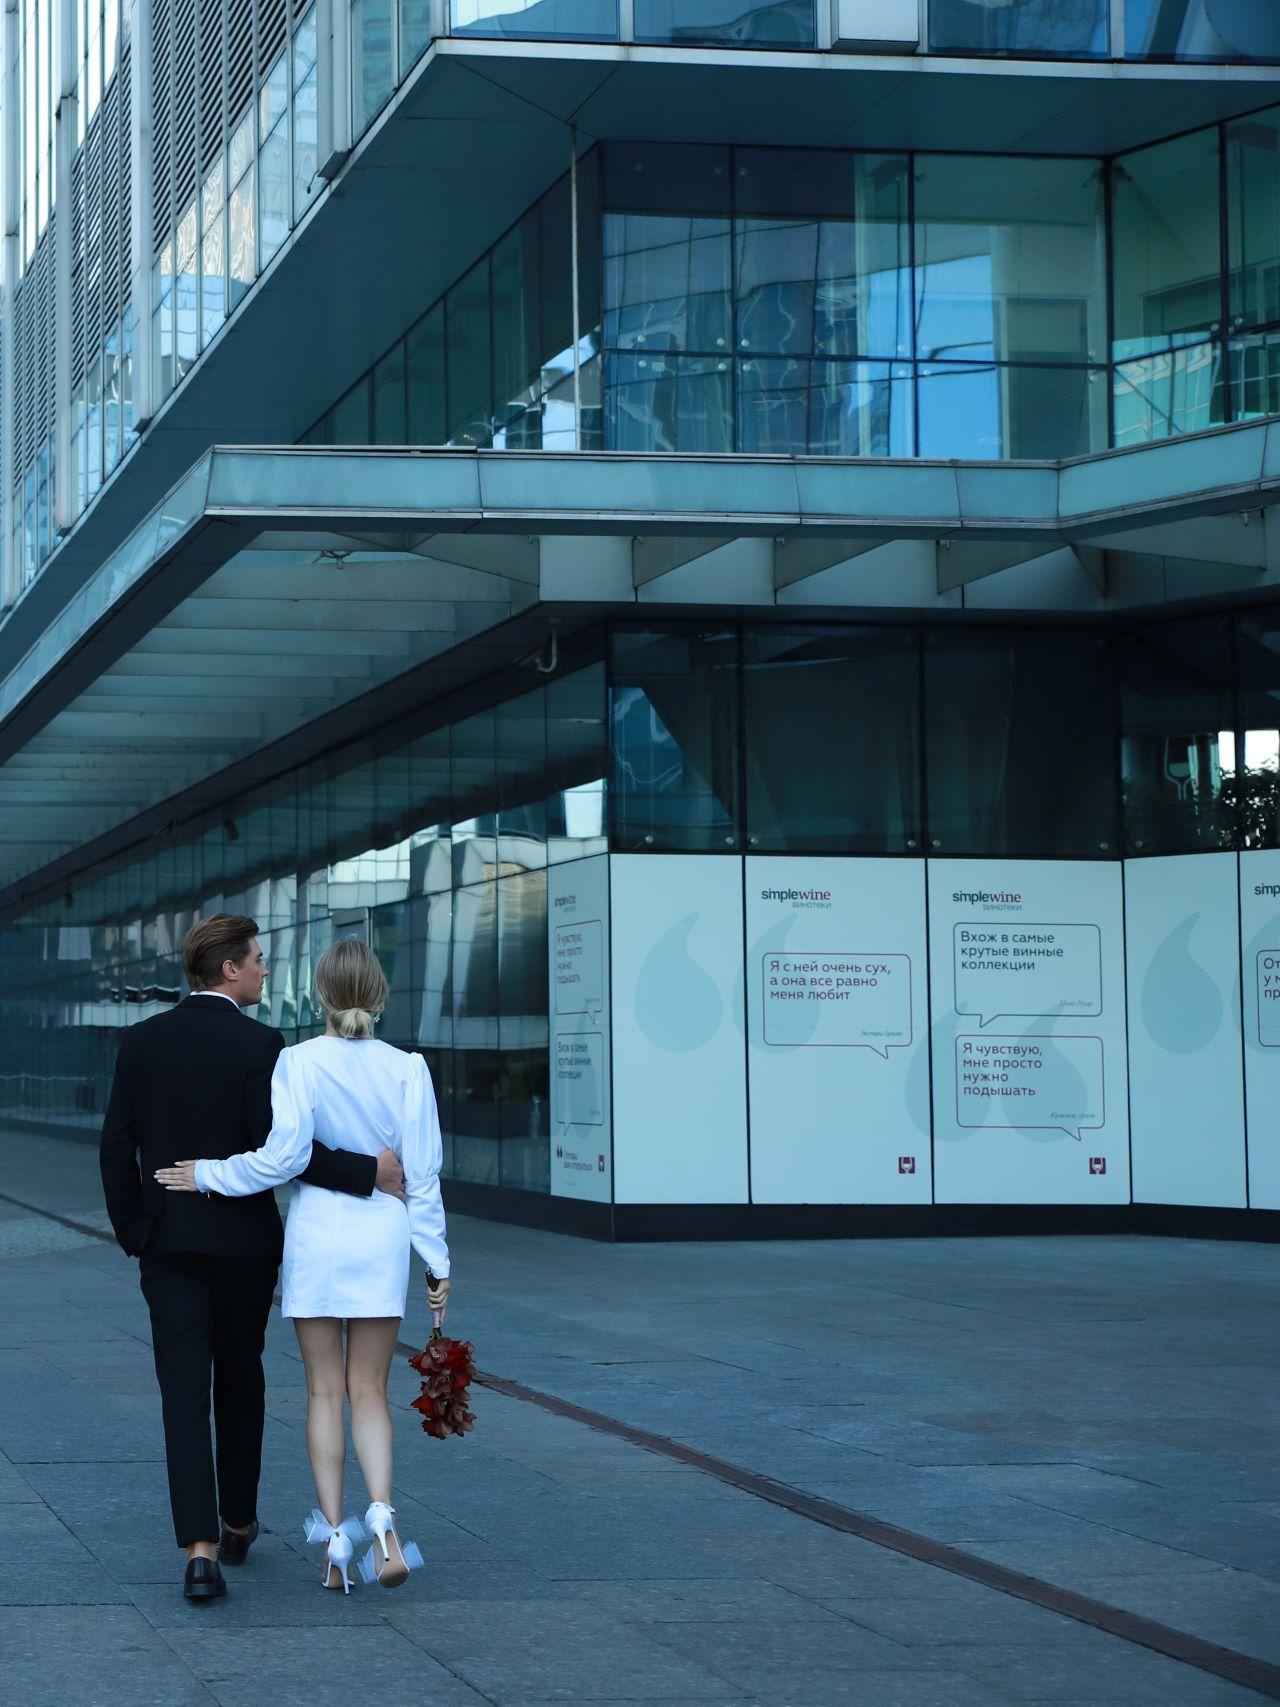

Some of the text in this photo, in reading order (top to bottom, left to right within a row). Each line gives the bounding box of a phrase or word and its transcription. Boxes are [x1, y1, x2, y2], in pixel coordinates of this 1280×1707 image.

[761, 888, 831, 903] simplewine
[952, 890, 1022, 905] simplewine
[961, 931, 1055, 943] Вхож в самые
[961, 947, 1064, 958] крутые винные
[770, 960, 891, 975] Я с ней очень сух,
[961, 961, 1035, 971] коллекции
[770, 977, 878, 989] а она все равно
[770, 989, 851, 1000] меня любит
[963, 1043, 1042, 1057] Я чувствую,
[963, 1059, 1042, 1070] мне просто
[963, 1073, 1008, 1083] нужно
[963, 1086, 1036, 1097] подышать
